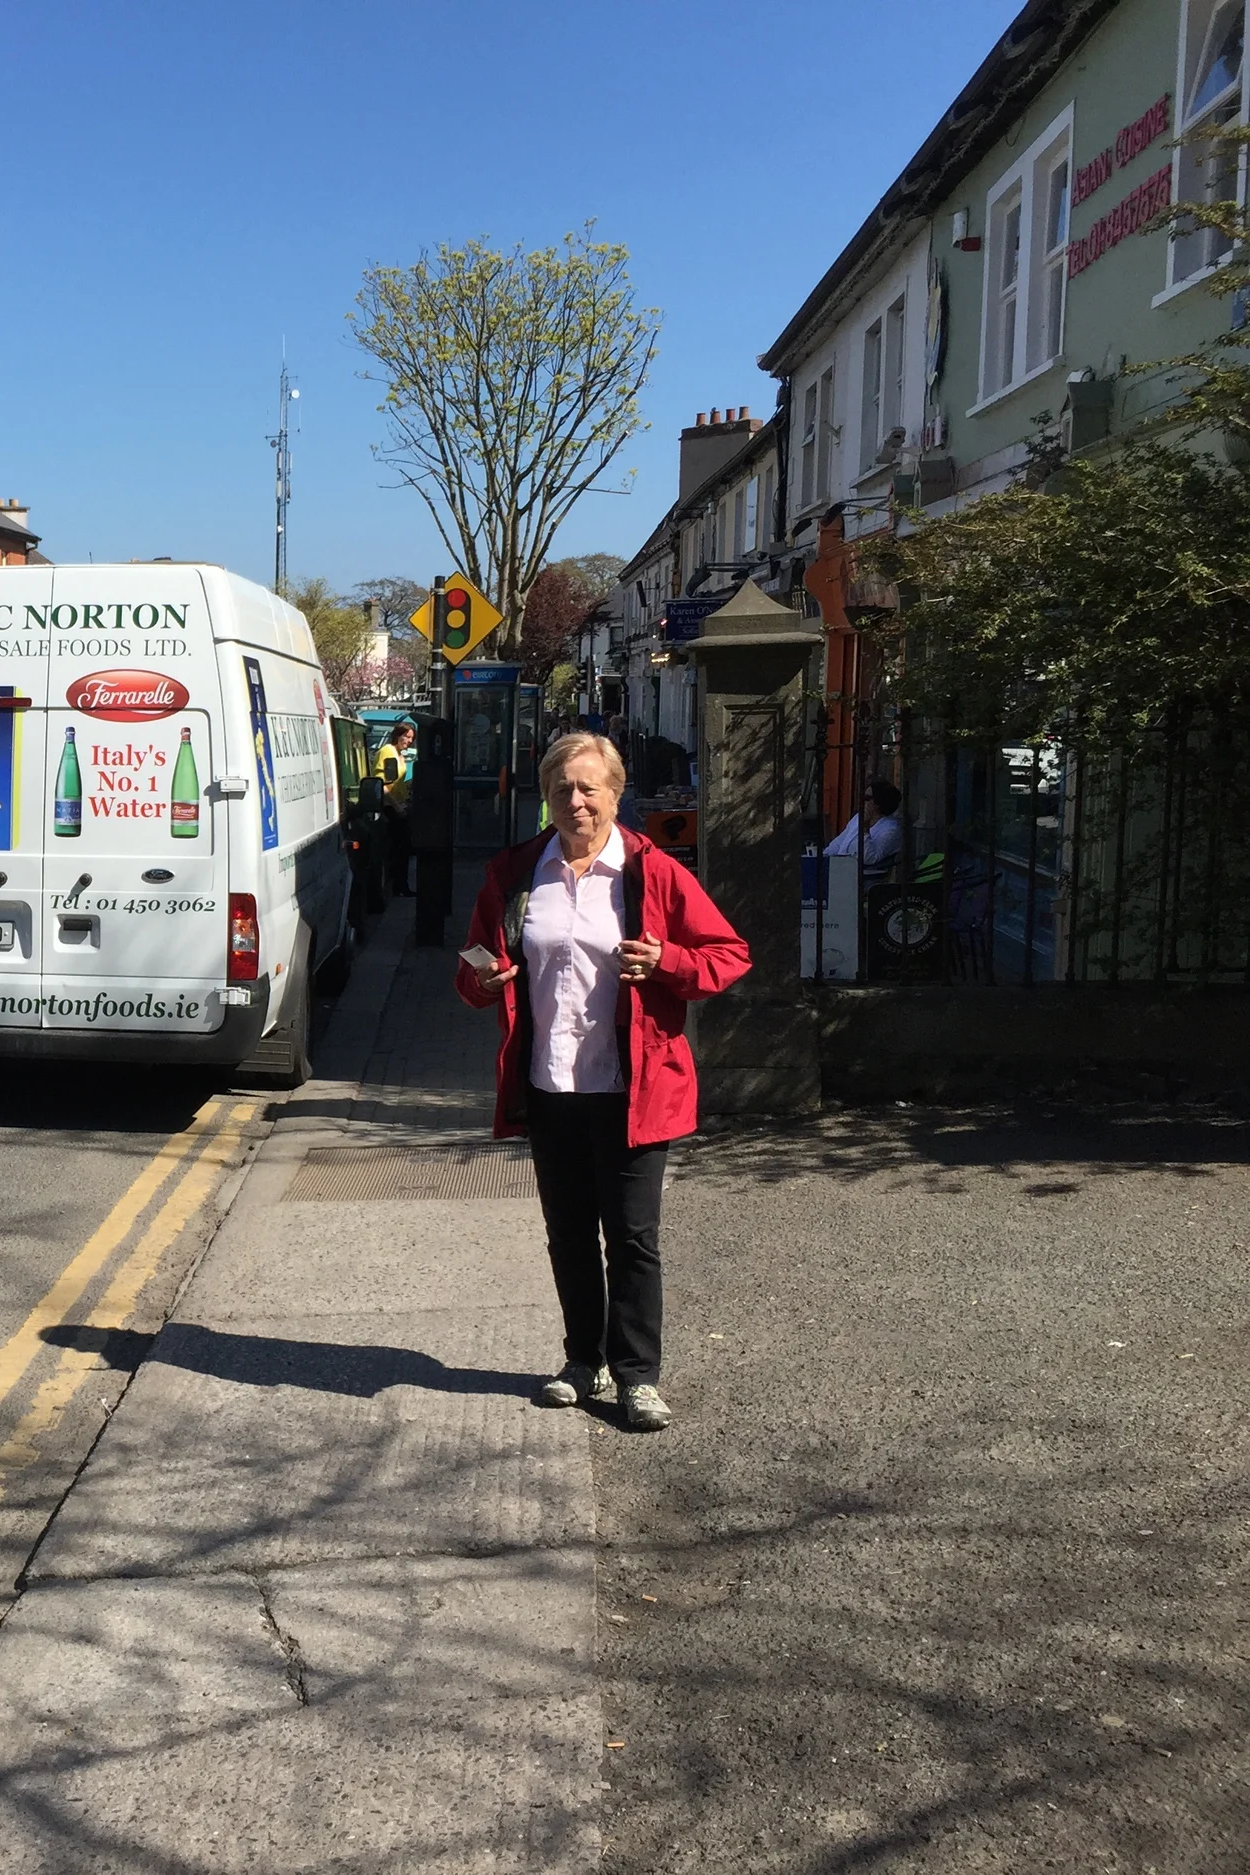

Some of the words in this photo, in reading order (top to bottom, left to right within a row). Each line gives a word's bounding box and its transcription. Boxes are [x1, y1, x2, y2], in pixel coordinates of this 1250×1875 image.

[1071, 146, 1112, 207] ASIAN
[1116, 92, 1172, 169] CUISINE
[22, 603, 191, 630] NORTON
[669, 606, 695, 615] Karen
[57, 639, 132, 657] FOODS
[143, 639, 192, 657] LTD.
[472, 670, 502, 680] eircom
[77, 679, 175, 709] Ferrarelle
[90, 744, 166, 772] Italy's
[97, 771, 139, 792] No.
[148, 775, 158, 792] 1
[88, 796, 167, 818] Water
[96, 898, 118, 910] 01
[123, 898, 161, 914] 450
[165, 896, 216, 915] 3062
